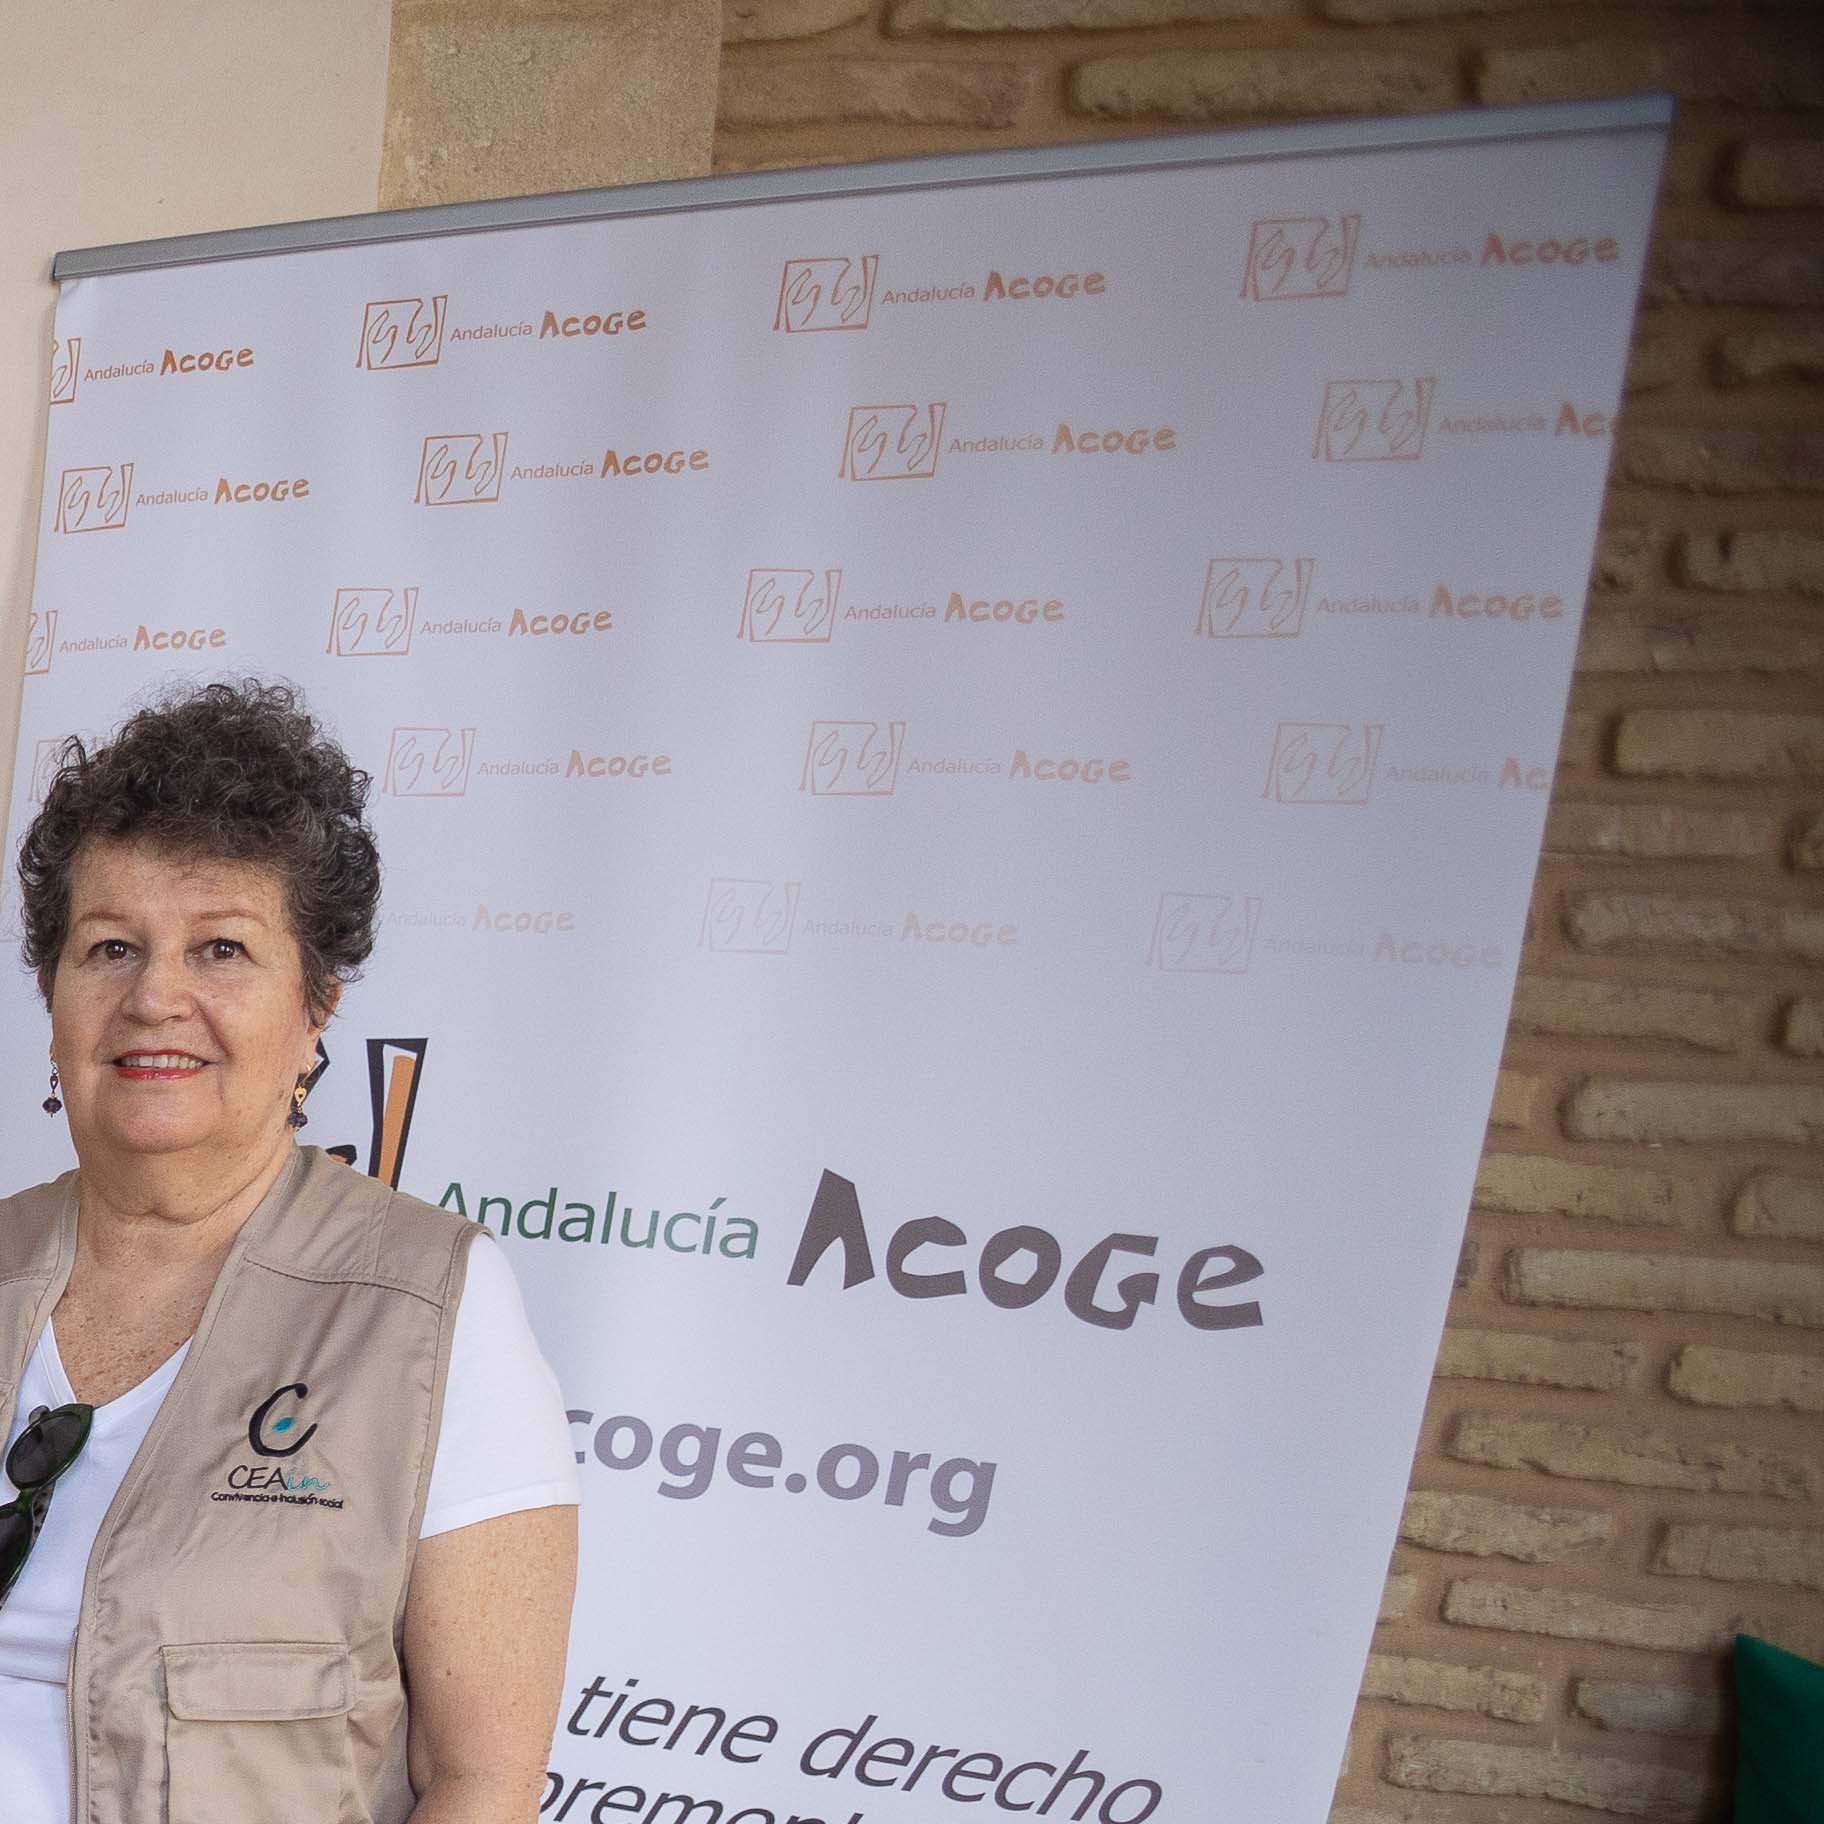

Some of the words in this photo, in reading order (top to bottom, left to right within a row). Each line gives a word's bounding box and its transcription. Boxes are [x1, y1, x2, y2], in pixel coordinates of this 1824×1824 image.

[881, 281, 976, 306] Andalucía
[450, 321, 533, 343] Andalucía
[83, 357, 155, 382] Andalucía
[950, 431, 1045, 454] Andalucía
[510, 459, 595, 481] Andalucía
[136, 485, 209, 507] Andalucía
[420, 616, 503, 637] Andalucía
[436, 1181, 761, 1261] Andalucía
[228, 1464, 332, 1492] CEAin
[211, 1491, 270, 1503] Convivencia
[279, 1492, 318, 1505] inclusión
[319, 1498, 344, 1509] social
[565, 1672, 779, 1765] tiene
